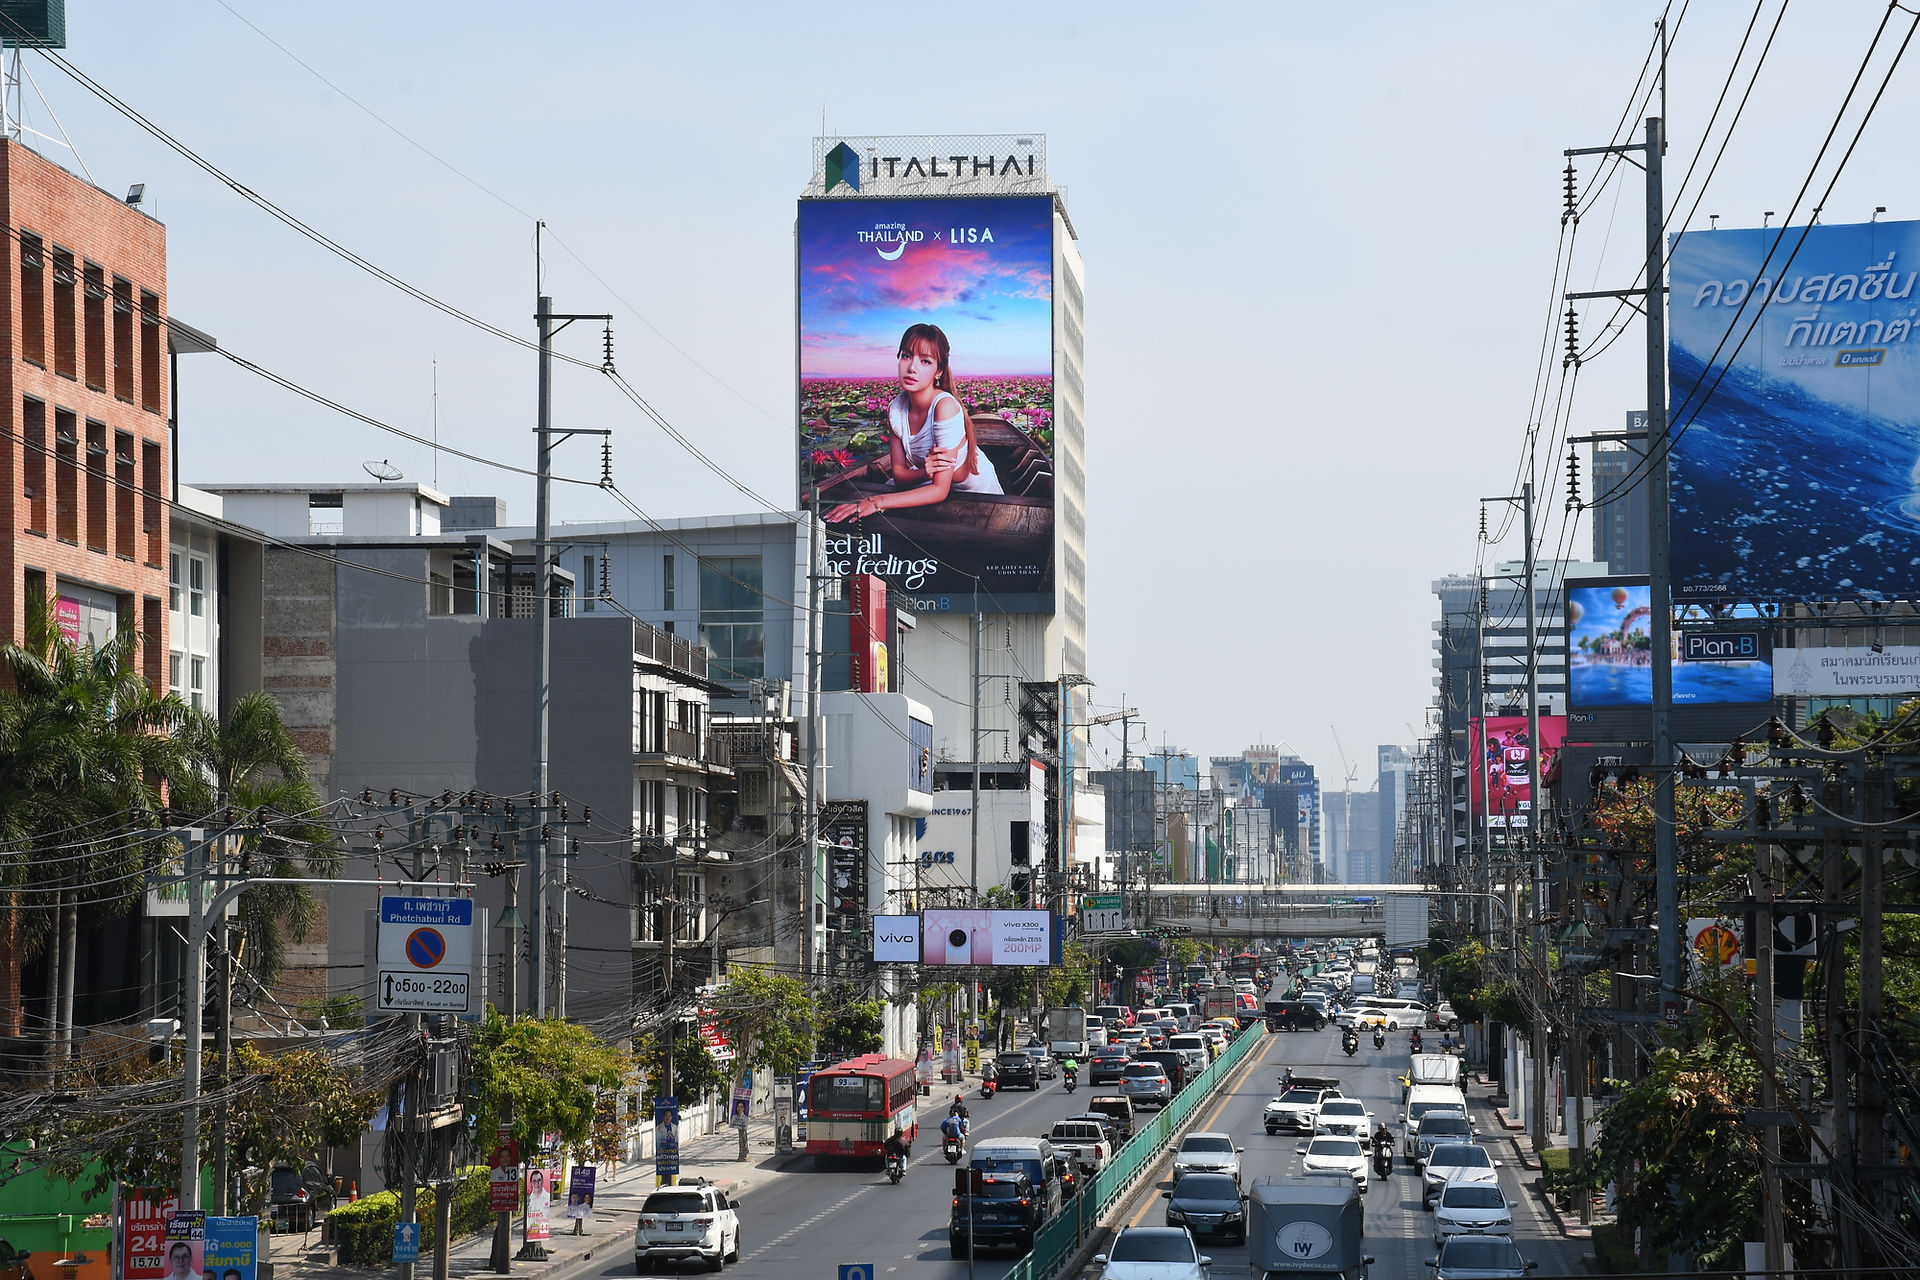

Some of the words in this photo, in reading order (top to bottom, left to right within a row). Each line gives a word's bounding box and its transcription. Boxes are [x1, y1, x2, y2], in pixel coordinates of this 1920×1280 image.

[872, 155, 1034, 178] ITALTHAI
[875, 222, 906, 231] amazing
[857, 231, 924, 242] THAILAND
[951, 228, 994, 243] LISA
[1693, 252, 1918, 308] ความสดชื่น
[825, 534, 852, 554] eel
[858, 534, 882, 554] all
[825, 555, 851, 575] he
[855, 554, 938, 590] feelings
[390, 913, 444, 923] Phetchaburi
[448, 915, 461, 924] Rd
[880, 933, 914, 943] vivo
[1004, 944, 1042, 953] 200MP
[506, 1169, 517, 1181] 13
[170, 1219, 189, 1228] เรียน
[191, 1230, 203, 1239] 44
[131, 1236, 157, 1252] 24
[1273, 1261, 1338, 1269] www.ivydecor.com
